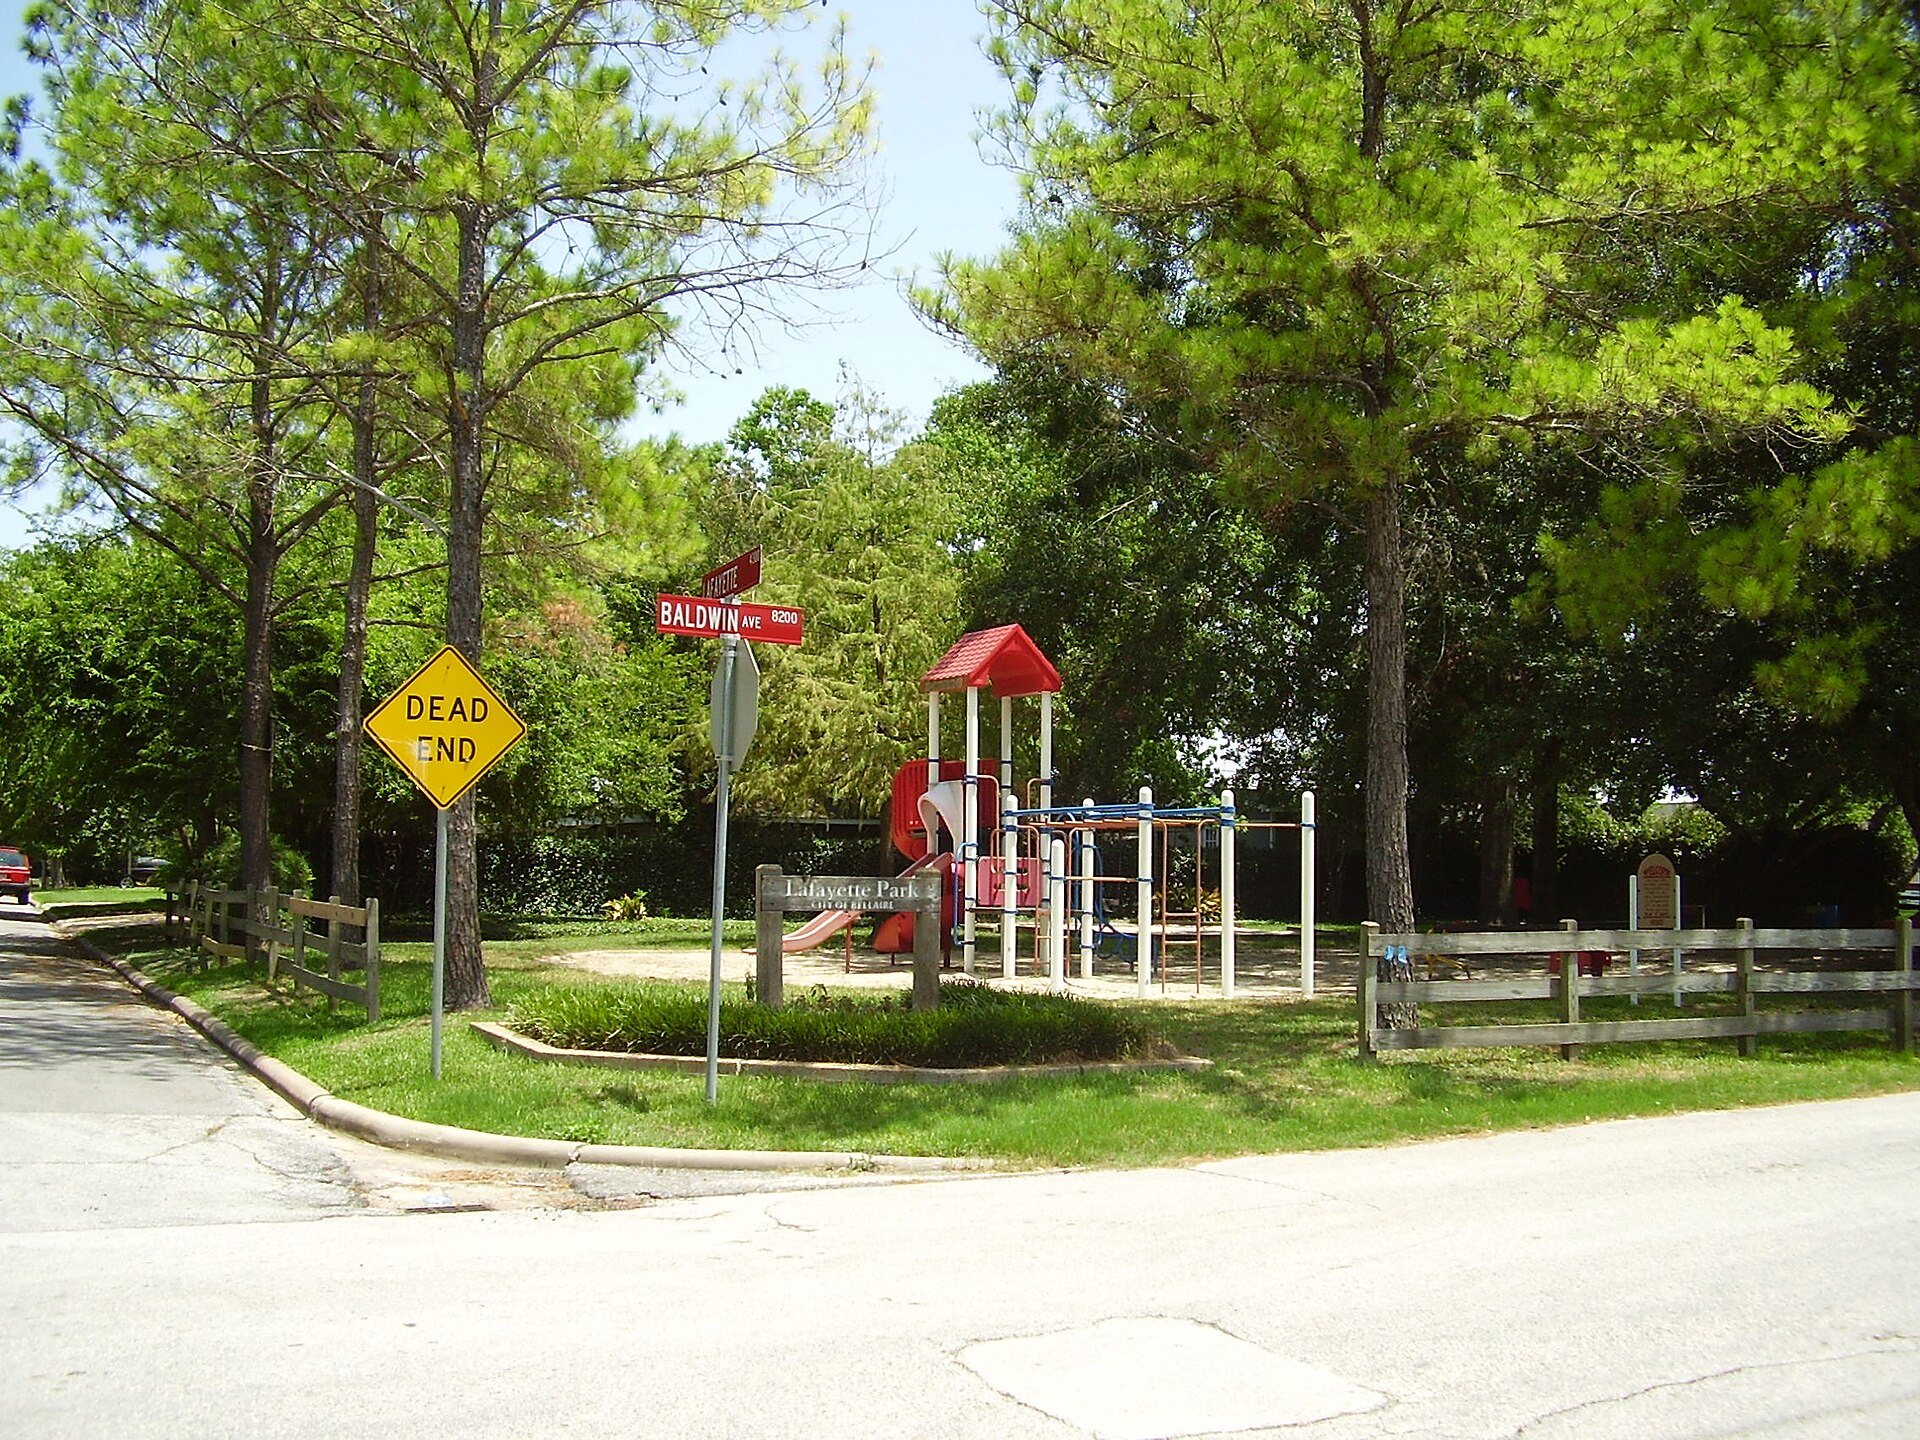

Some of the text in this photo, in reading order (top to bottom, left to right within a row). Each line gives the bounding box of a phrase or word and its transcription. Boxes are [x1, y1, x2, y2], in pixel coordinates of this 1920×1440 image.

[660, 601, 798, 632] BALDWIN AVE 8200
[406, 695, 489, 723] DEAD
[416, 736, 477, 763] END
[784, 878, 920, 900] Lafayette Park
[811, 900, 894, 910] CITY OF BELLAIRE
